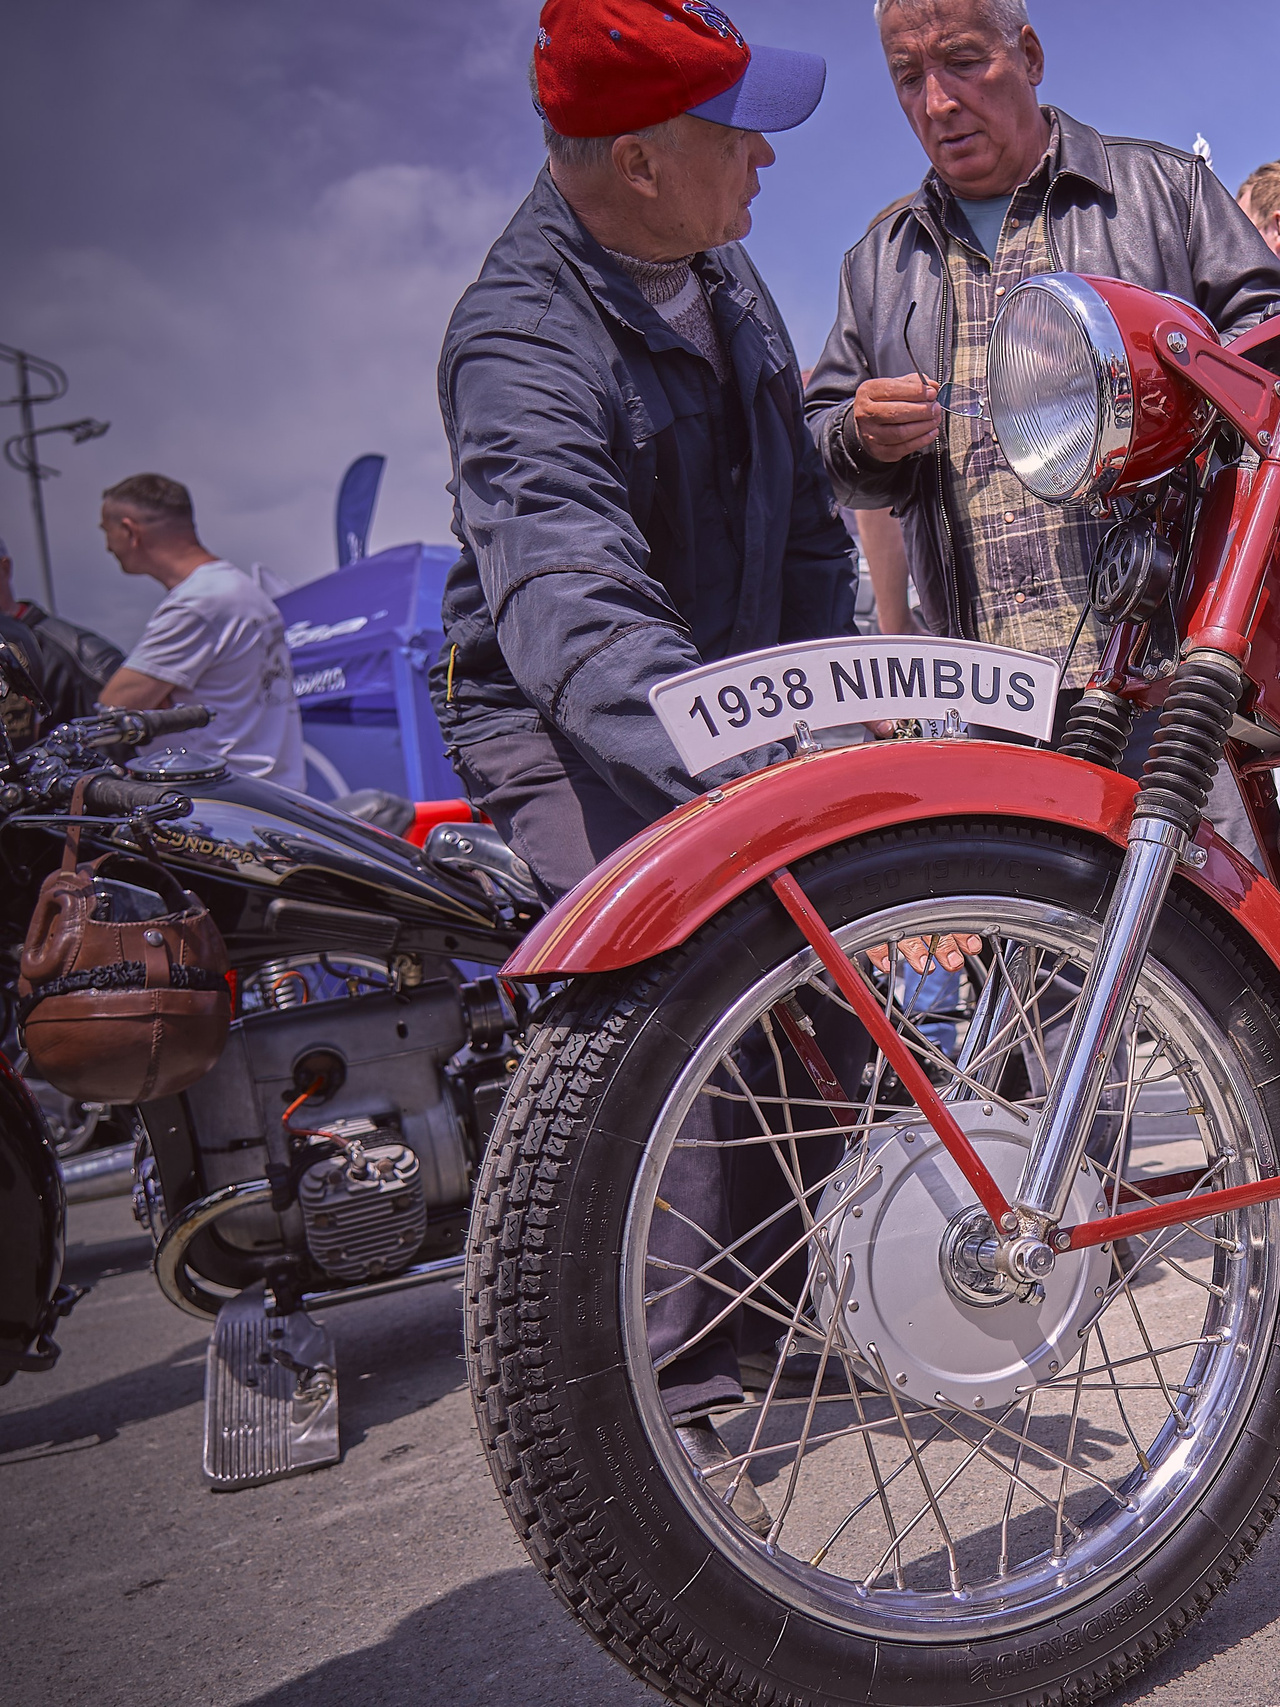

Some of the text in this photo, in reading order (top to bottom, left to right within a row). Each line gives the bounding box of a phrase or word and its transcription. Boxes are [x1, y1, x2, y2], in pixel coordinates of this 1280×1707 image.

[688, 657, 1037, 738] 1938 NIMBUS
[996, 1583, 1154, 1679] HEIDENAU
